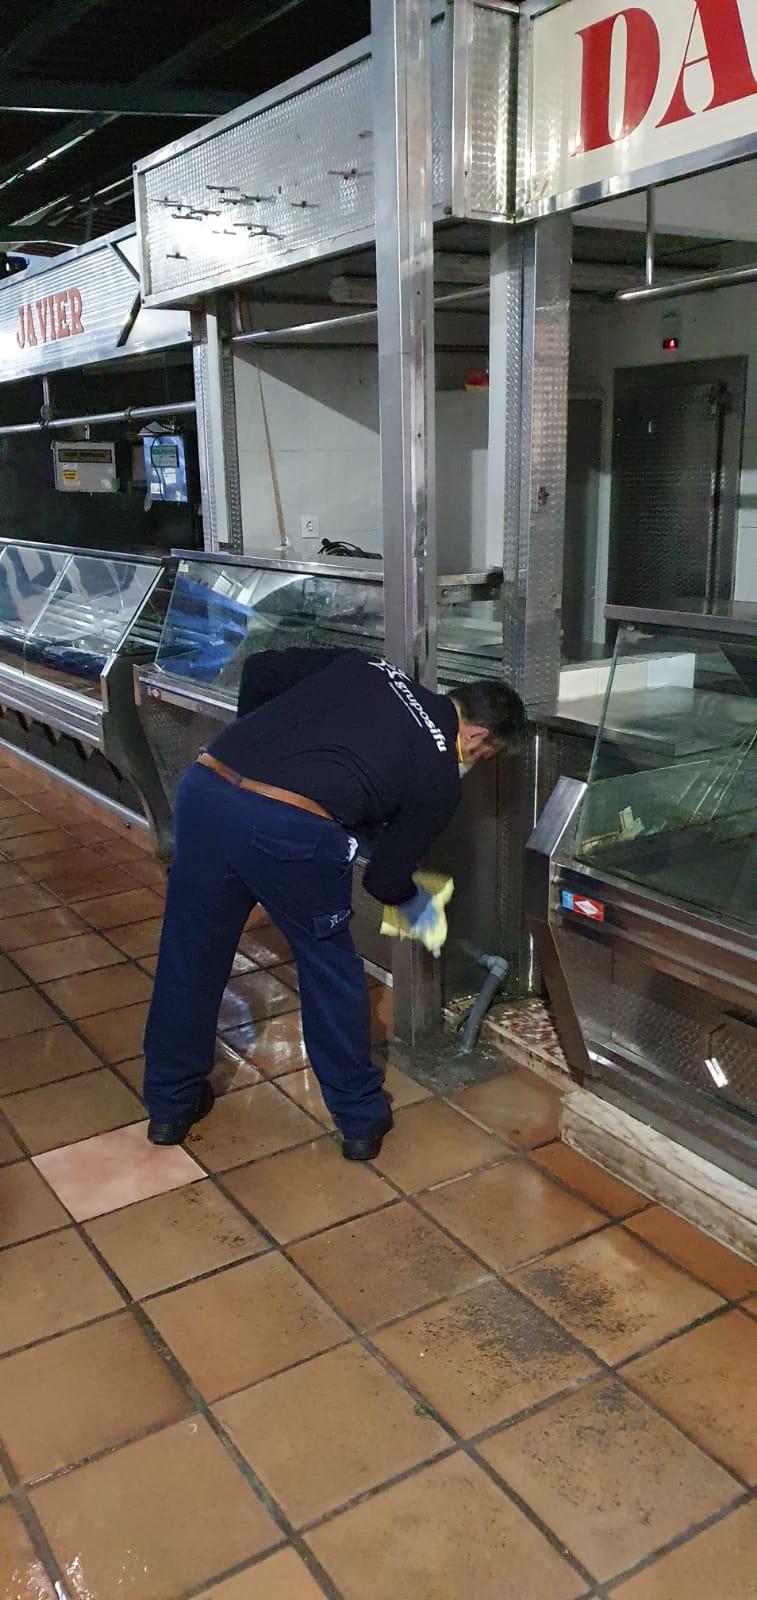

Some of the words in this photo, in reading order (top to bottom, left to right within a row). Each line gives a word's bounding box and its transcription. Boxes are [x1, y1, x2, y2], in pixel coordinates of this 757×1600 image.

[571, 0, 757, 157] DA
[16, 287, 84, 349] JAVIER
[393, 680, 448, 753] gruposifu
